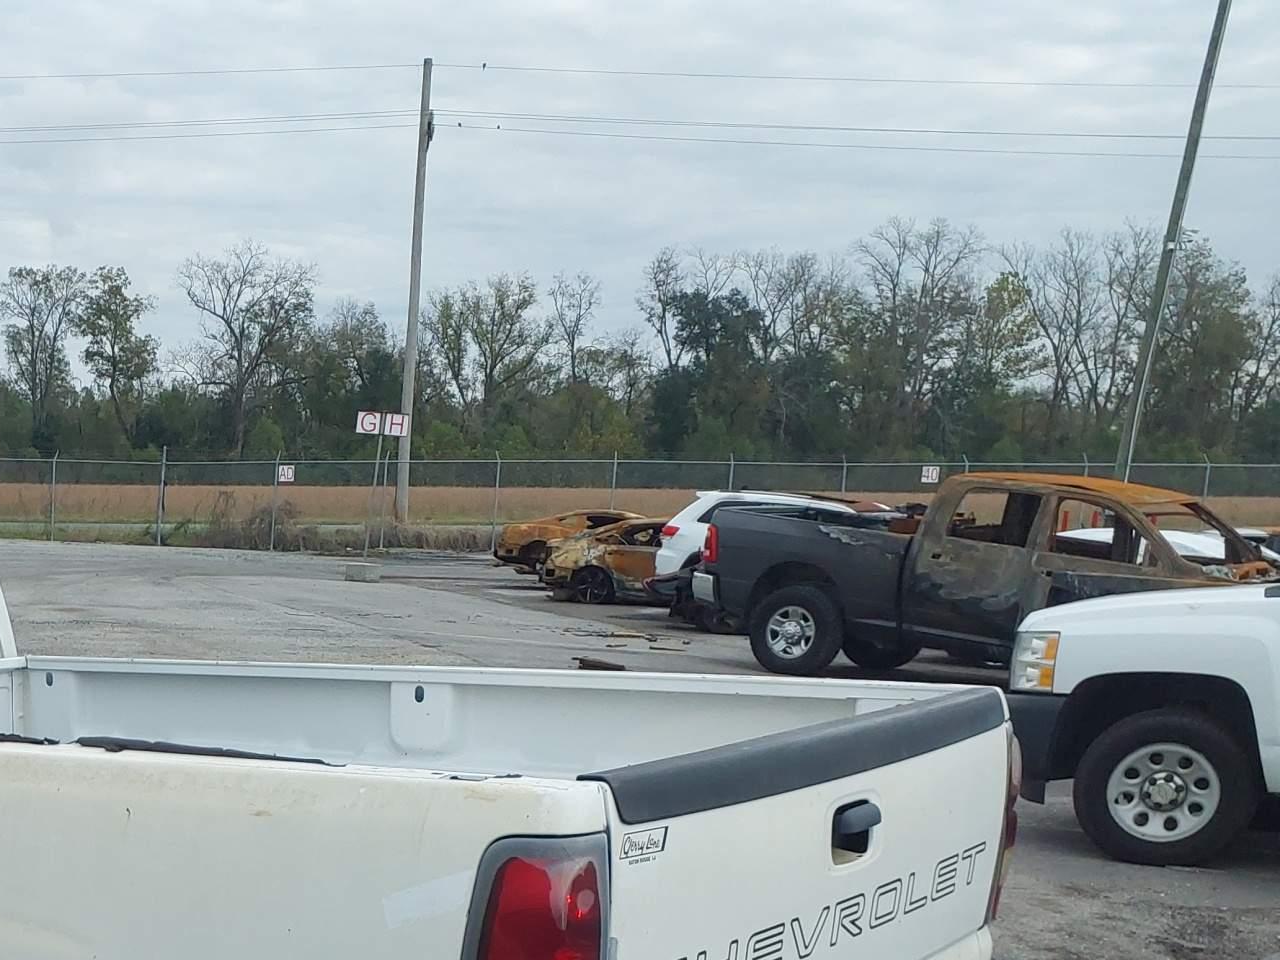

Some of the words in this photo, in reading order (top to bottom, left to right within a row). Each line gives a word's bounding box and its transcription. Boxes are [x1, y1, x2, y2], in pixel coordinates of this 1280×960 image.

[360, 412, 377, 432] G
[388, 414, 405, 435] H
[279, 466, 294, 480] AD
